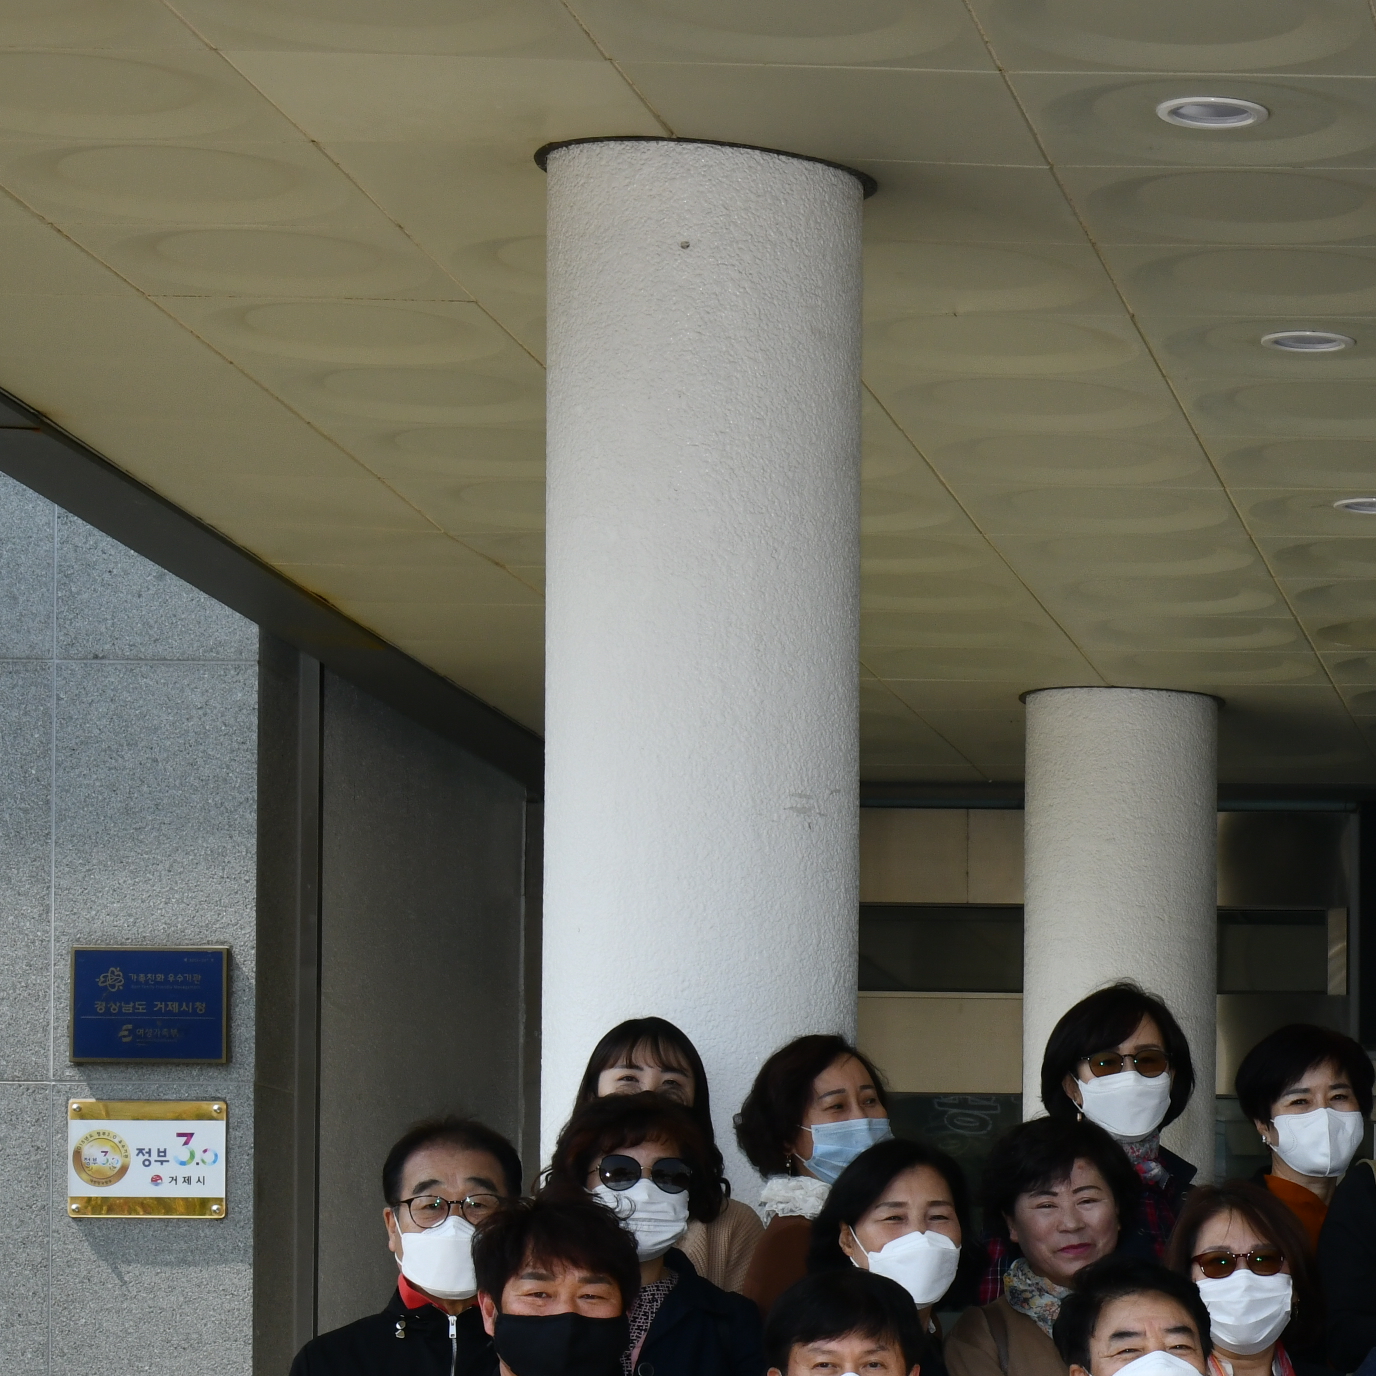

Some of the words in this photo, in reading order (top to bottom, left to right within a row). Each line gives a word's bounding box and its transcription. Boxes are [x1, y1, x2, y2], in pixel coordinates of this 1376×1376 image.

[129, 973, 164, 984] 가족친화
[168, 973, 202, 984] 우수기관
[94, 1001, 147, 1014] 경상남도
[153, 1001, 206, 1014] 거제시청
[136, 1028, 179, 1038] 여성가족부
[136, 1147, 170, 1168] 정부
[173, 1132, 219, 1167] 3.0
[168, 1174, 206, 1186] 거제시
